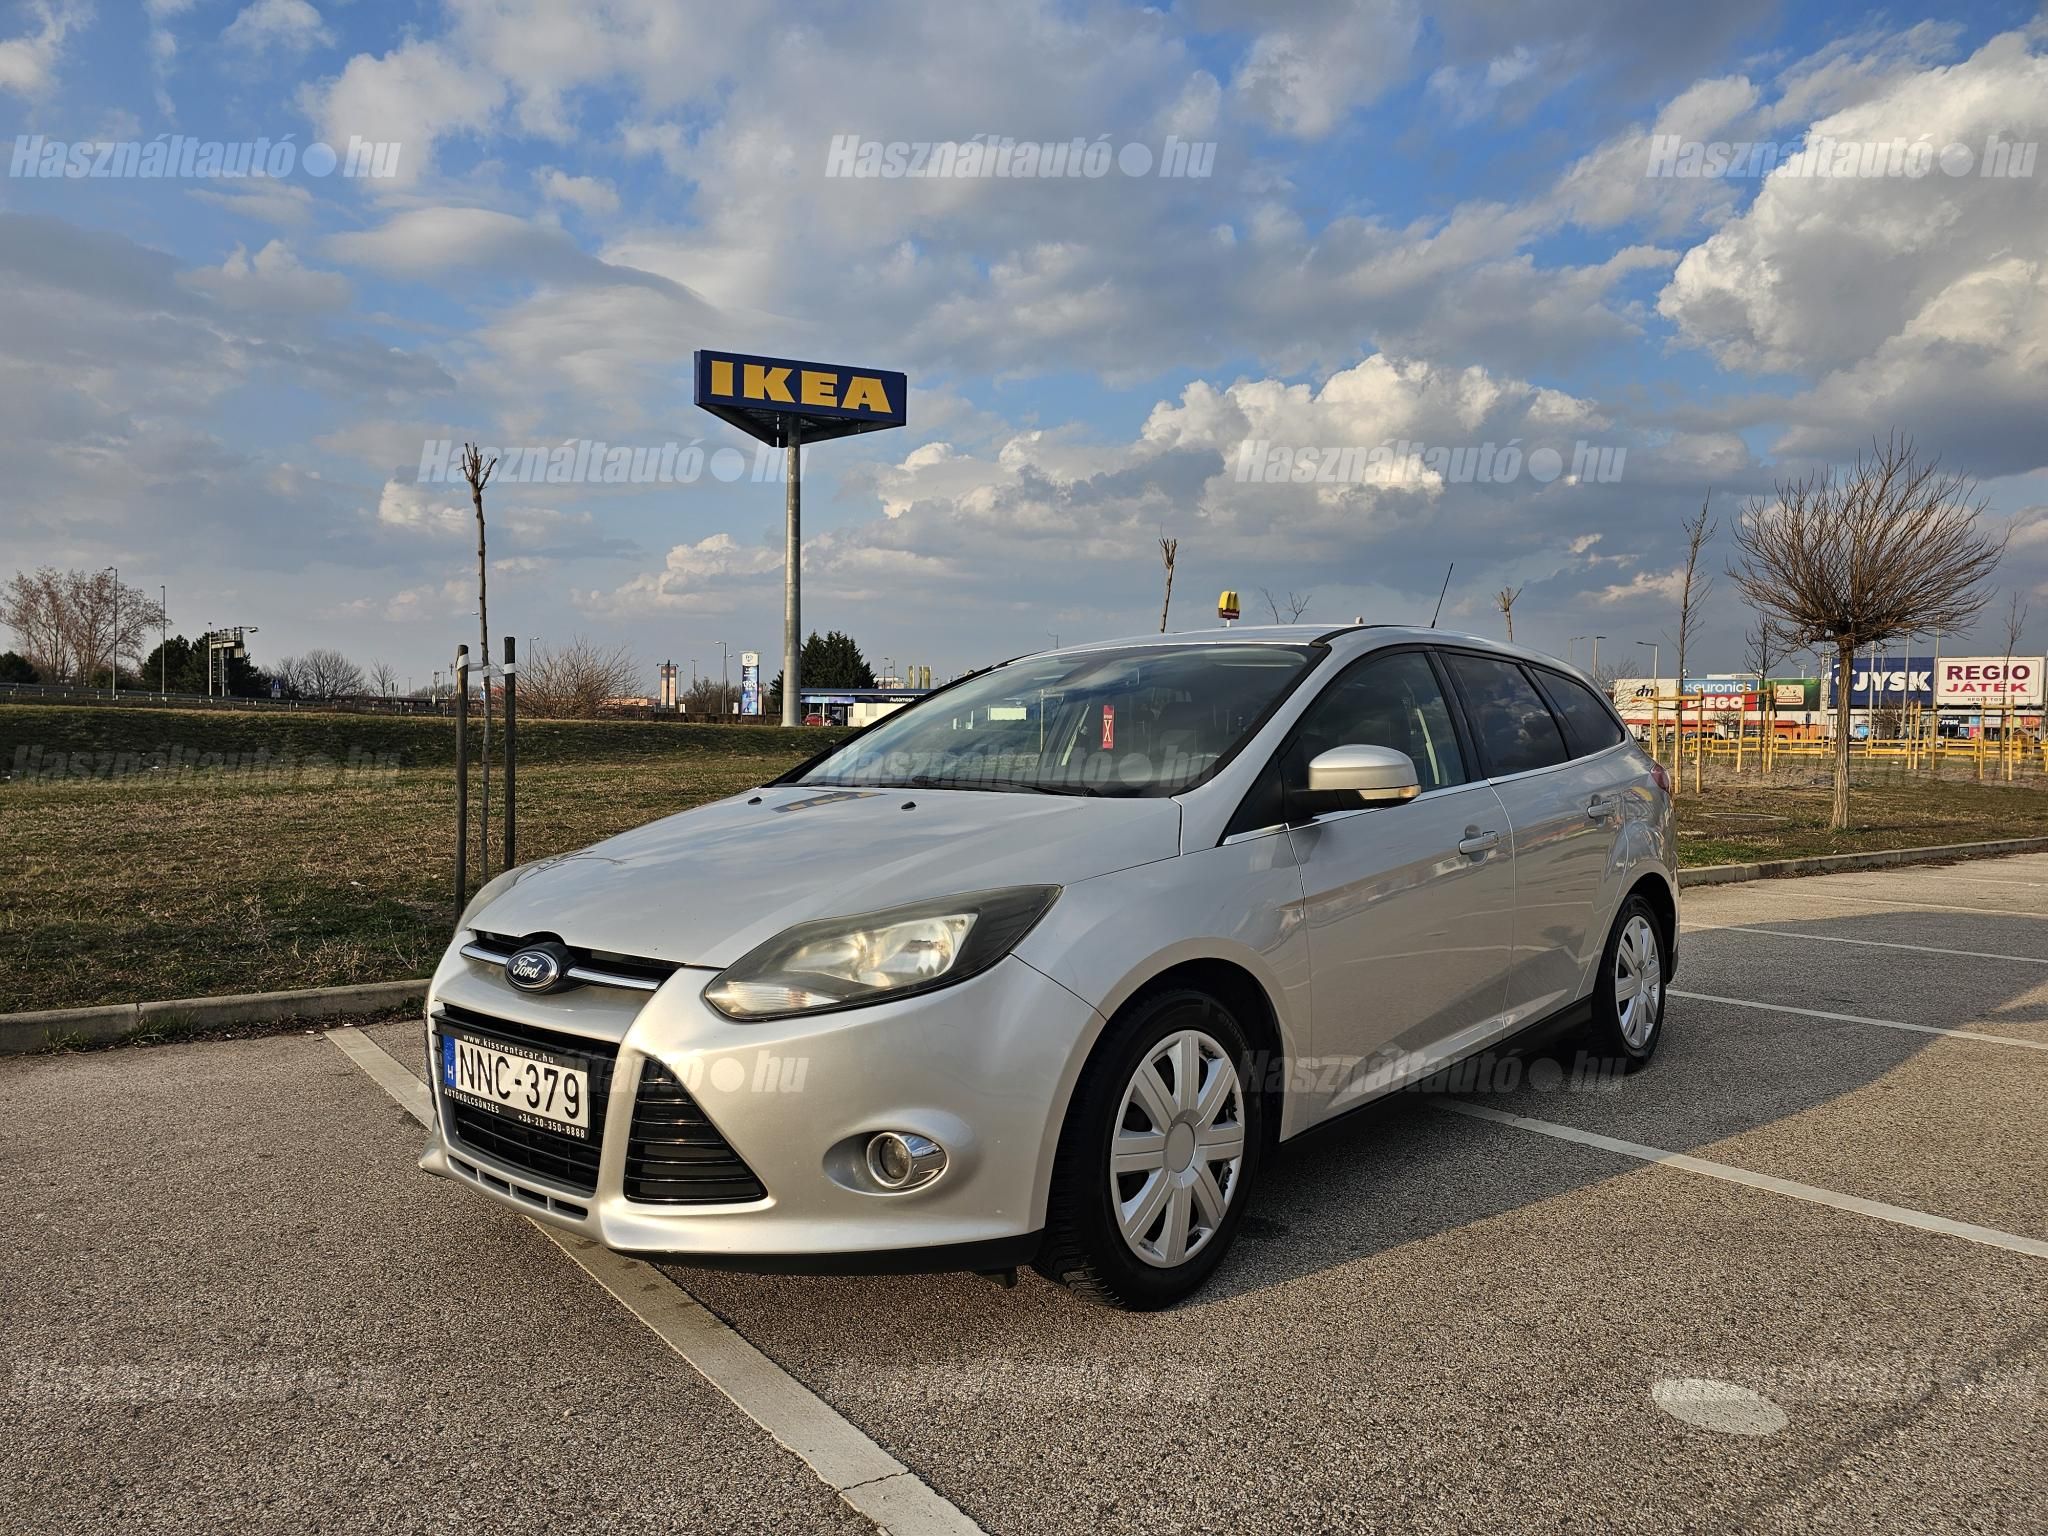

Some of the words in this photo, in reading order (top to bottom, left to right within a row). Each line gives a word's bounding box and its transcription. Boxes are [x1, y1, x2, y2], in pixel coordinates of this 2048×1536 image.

[711, 360, 893, 414] IKEA
[1853, 671, 1932, 692] JYSK
[1946, 665, 2031, 681] REGIO
[1693, 681, 1752, 693] euronics
[1946, 681, 2028, 693] JÁTÉK
[512, 955, 543, 979] Ford
[463, 1034, 555, 1065] www.kissrentacar.hu
[446, 1063, 455, 1081] H
[459, 1044, 581, 1120] NNC-379
